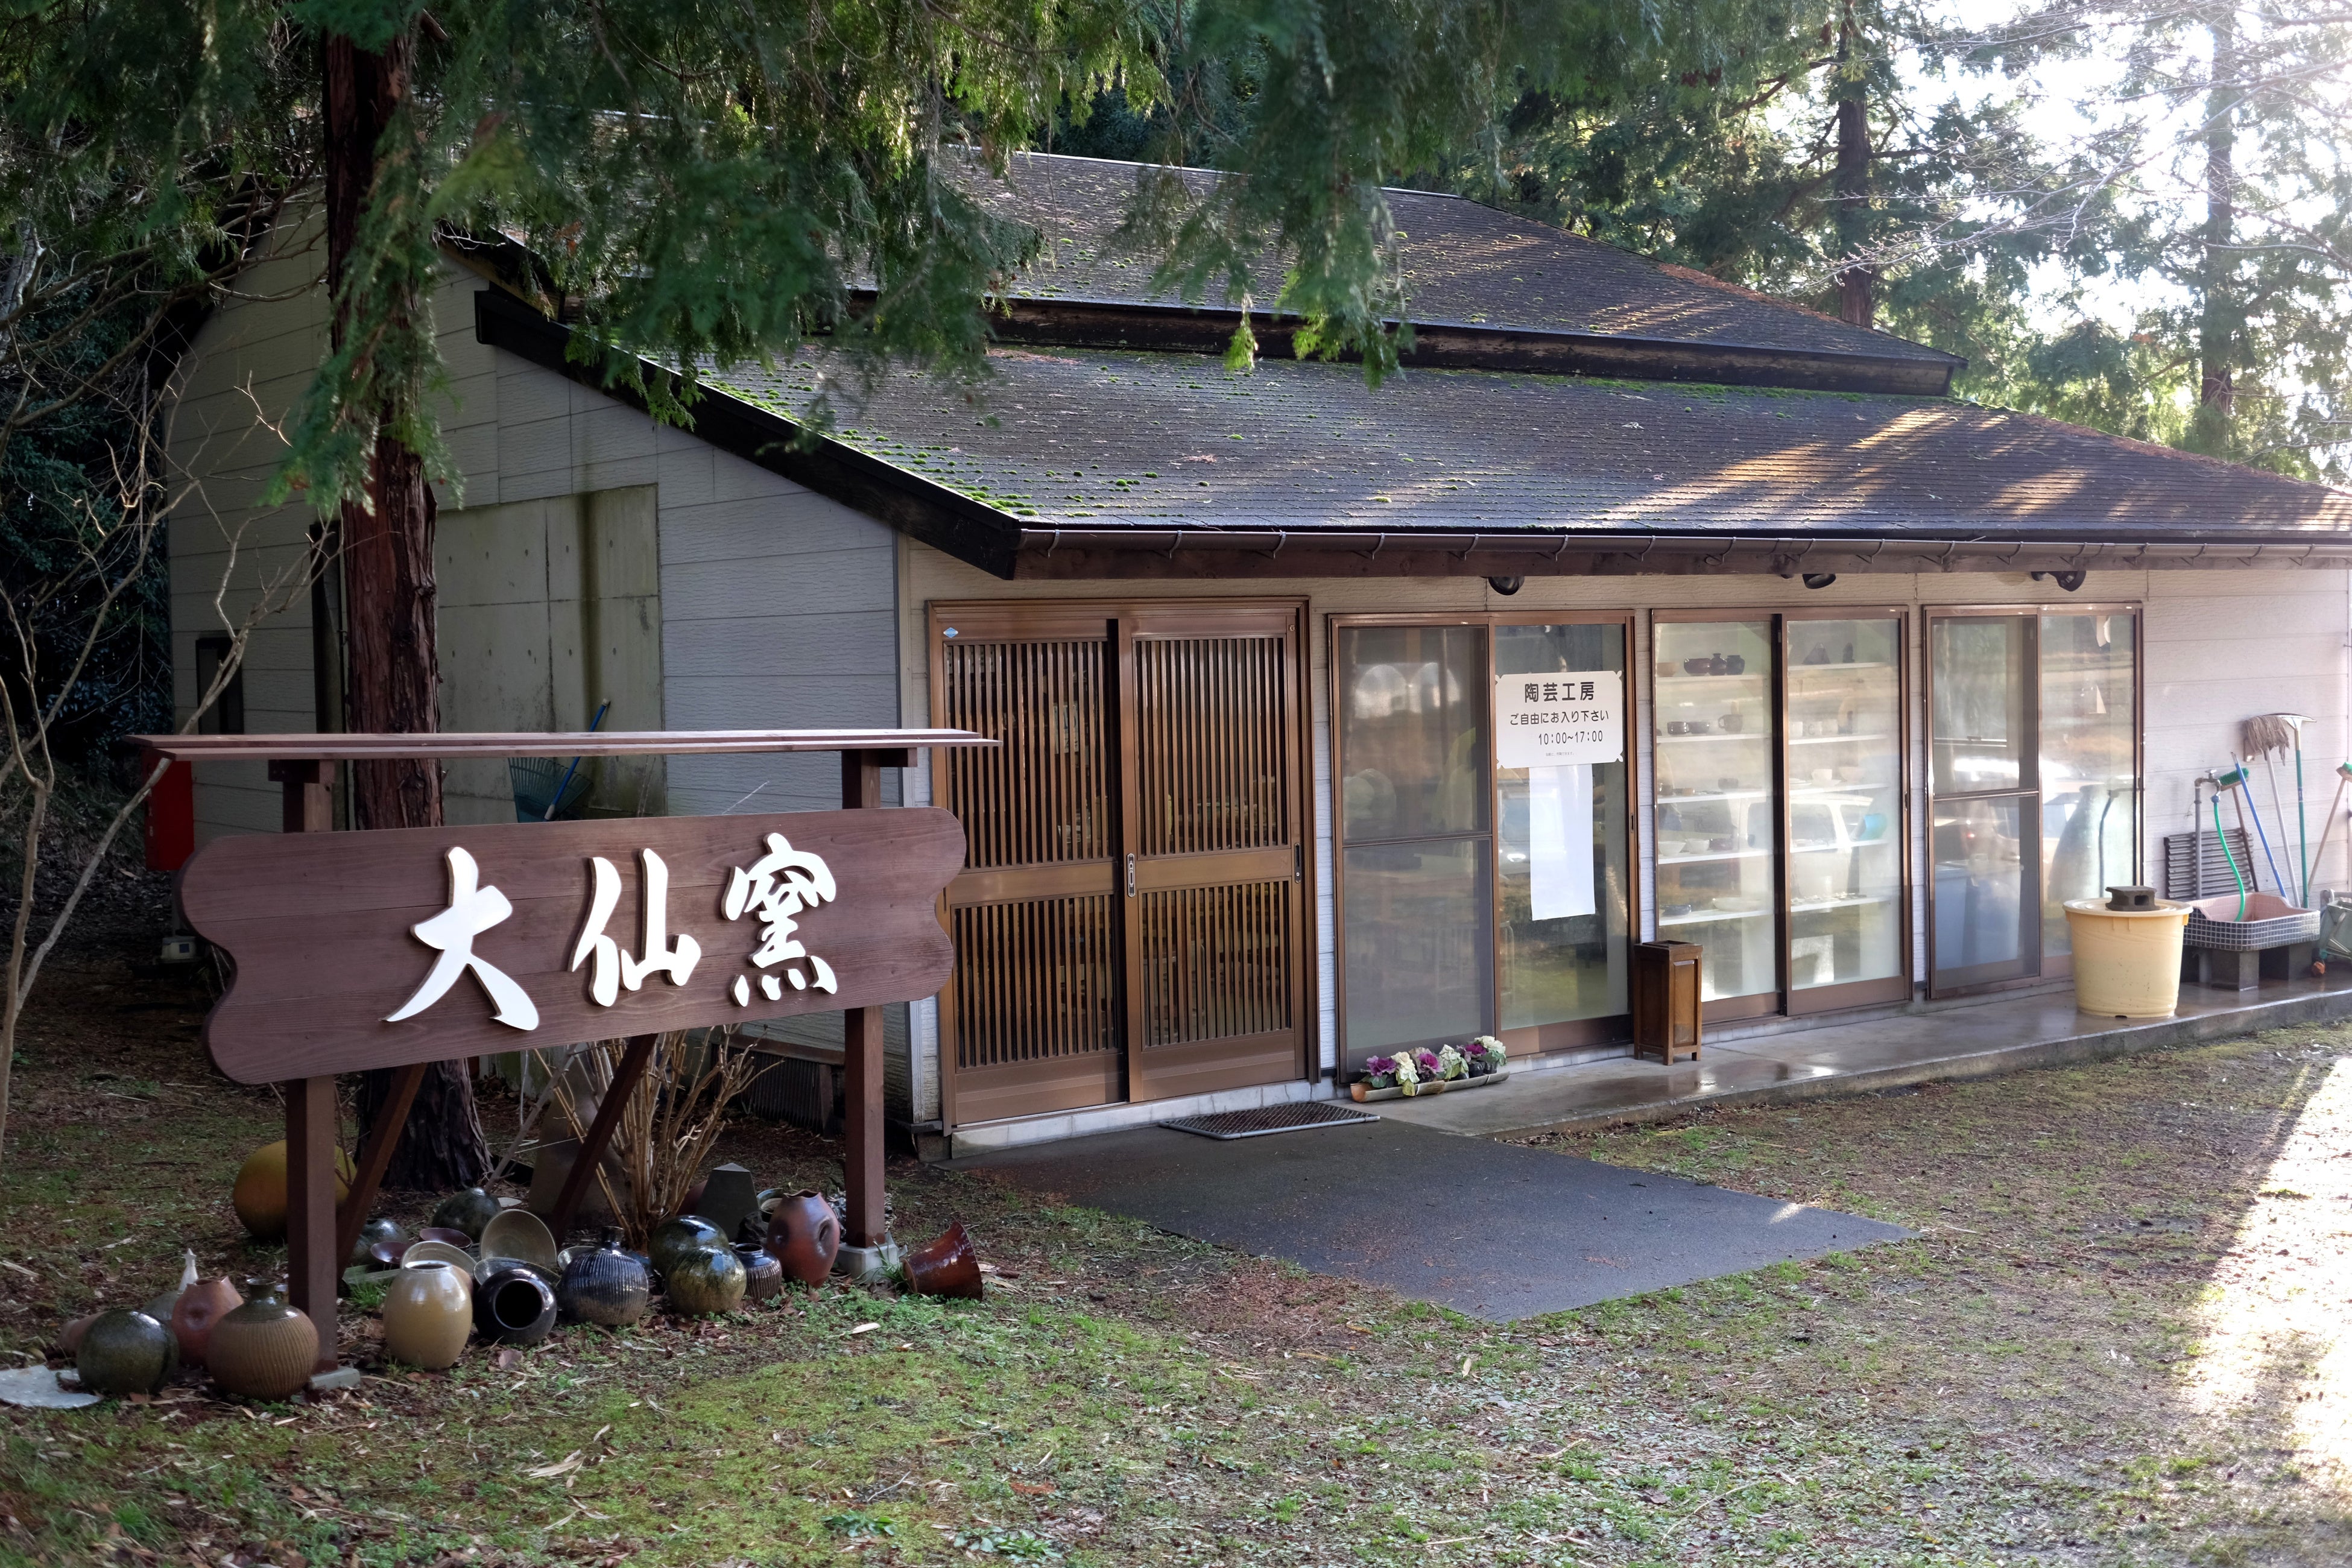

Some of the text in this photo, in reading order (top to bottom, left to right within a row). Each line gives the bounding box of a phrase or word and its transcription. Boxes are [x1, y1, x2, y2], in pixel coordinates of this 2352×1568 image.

[1525, 681, 1595, 703] 陶芸工房
[1510, 710, 1609, 726] ご自由にお入り下さい
[379, 833, 838, 1031] 大仙窯
